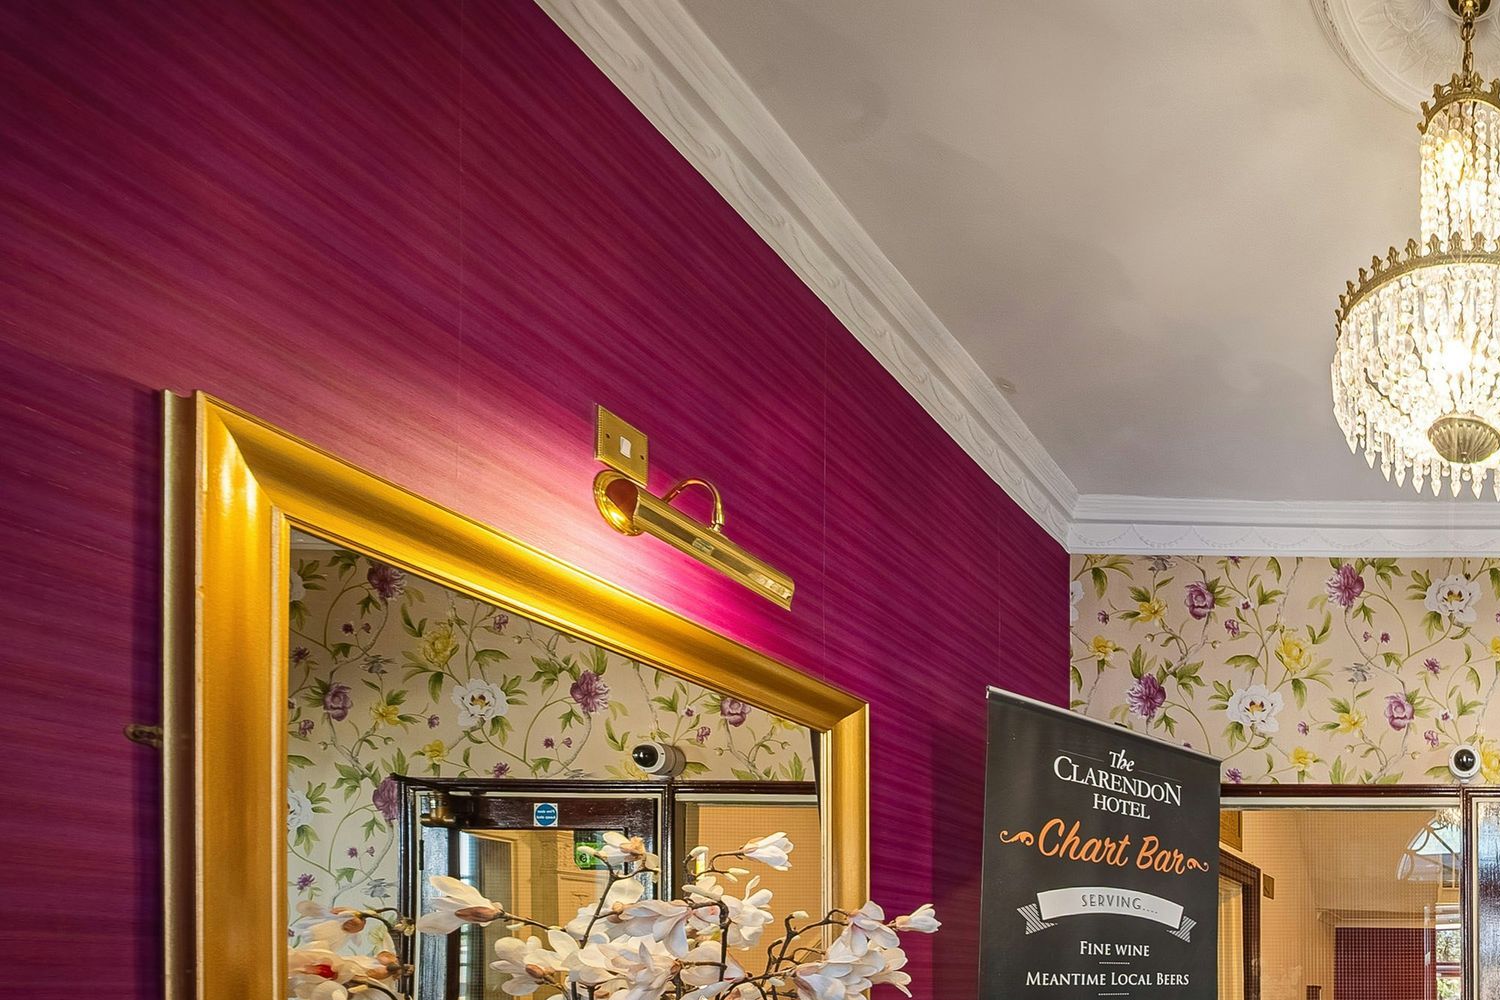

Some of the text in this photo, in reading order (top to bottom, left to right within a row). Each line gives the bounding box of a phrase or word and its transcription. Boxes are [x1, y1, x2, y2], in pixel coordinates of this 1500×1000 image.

[1109, 749, 1135, 772] The
[1053, 755, 1182, 806] CLARENDON
[1093, 793, 1150, 820] HOTEL
[1038, 818, 1187, 875] Chart Bar
[1079, 941, 1150, 957] FINE WINE
[1026, 971, 1190, 987] MEANTIME LOCAL BEERS
